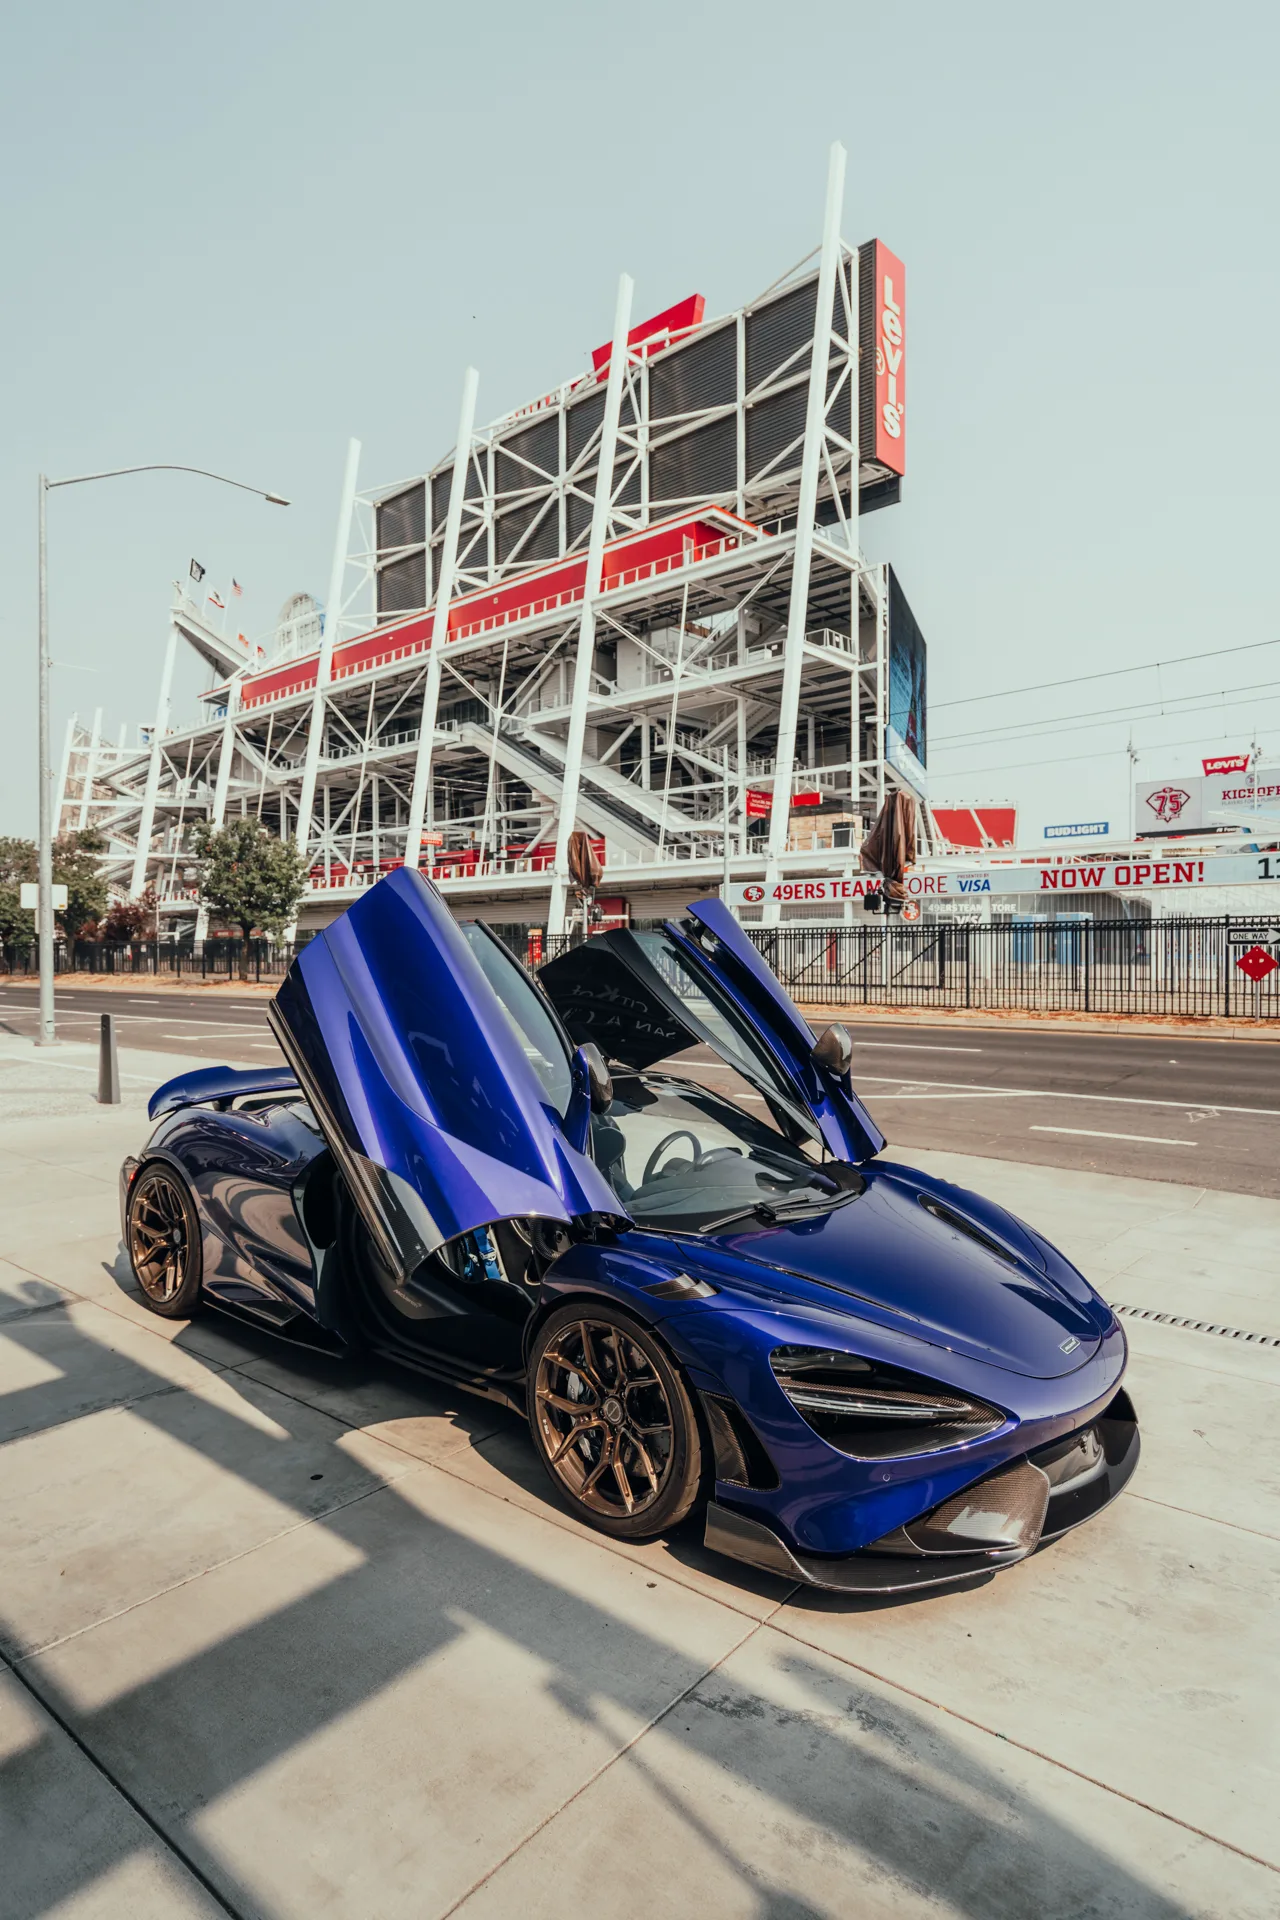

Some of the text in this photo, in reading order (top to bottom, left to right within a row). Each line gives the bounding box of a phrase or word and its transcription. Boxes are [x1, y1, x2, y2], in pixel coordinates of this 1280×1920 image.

[1156, 794, 1182, 813] 75
[1040, 862, 1204, 889] NOW OPEN!
[772, 883, 825, 900] 49ERS
[830, 879, 881, 898] TEAM
[957, 879, 991, 892] VISA
[928, 903, 958, 912] 49ERS
[991, 903, 1017, 912] TORE
[1232, 932, 1269, 940] ONE WAY
